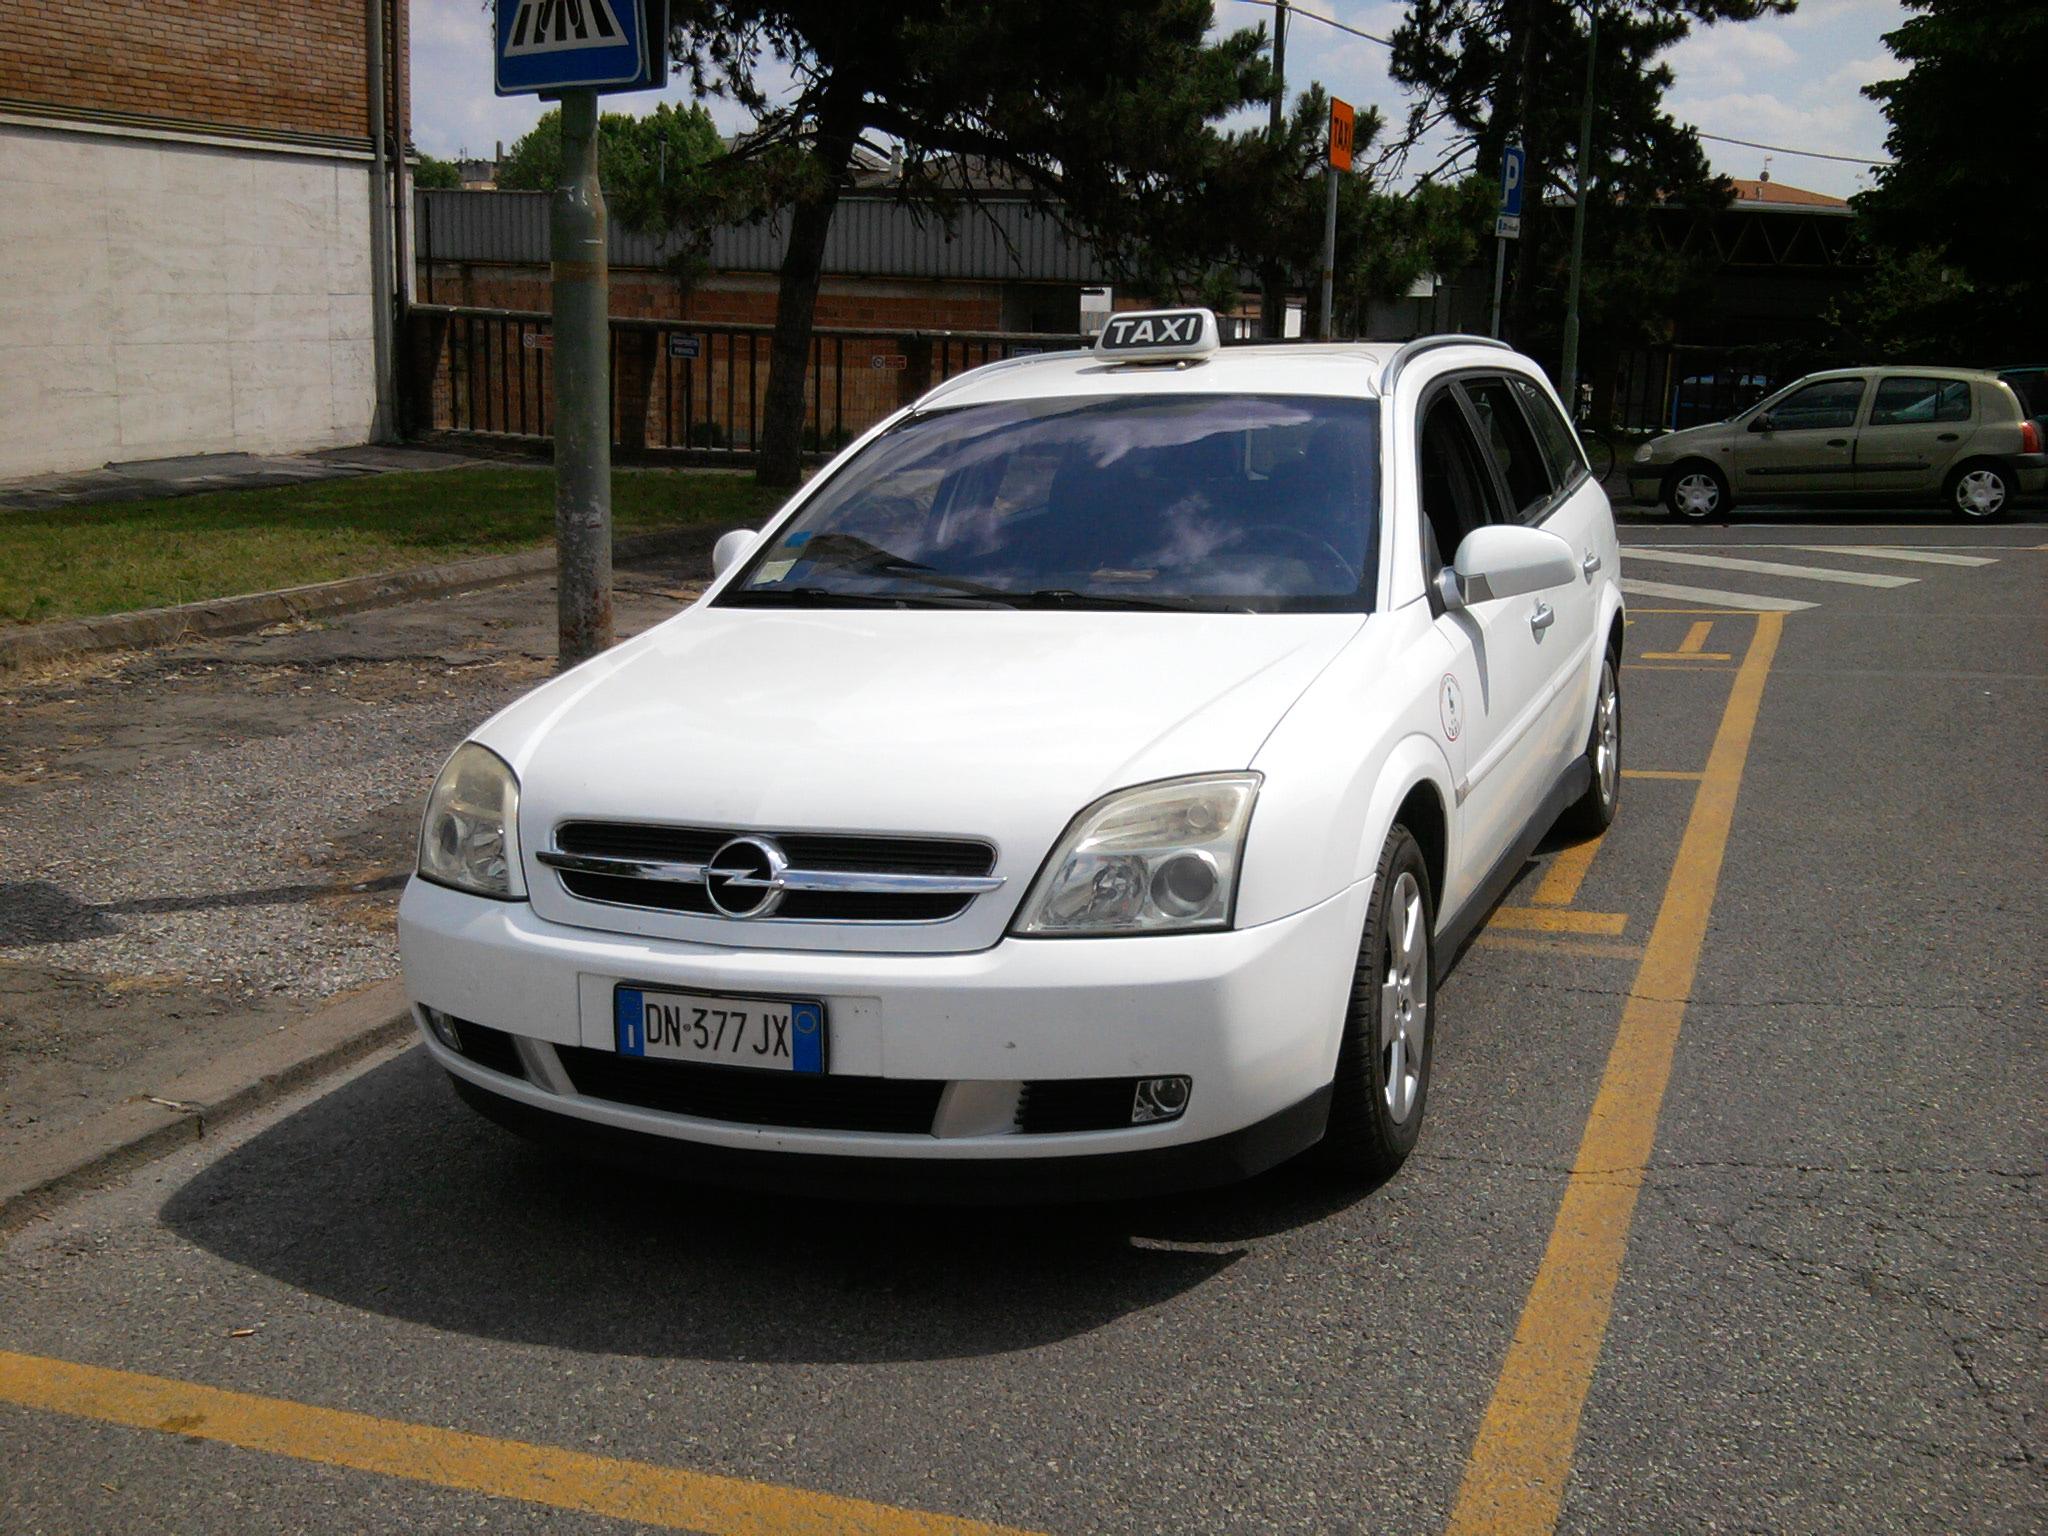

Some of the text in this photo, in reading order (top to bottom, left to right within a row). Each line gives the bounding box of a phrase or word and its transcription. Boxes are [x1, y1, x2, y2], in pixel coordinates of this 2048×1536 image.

[1501, 153, 1519, 207] P
[1112, 317, 1197, 344] TAXI
[645, 1003, 681, 1047] DN
[692, 1007, 748, 1052] 377
[753, 1013, 790, 1057] JX
